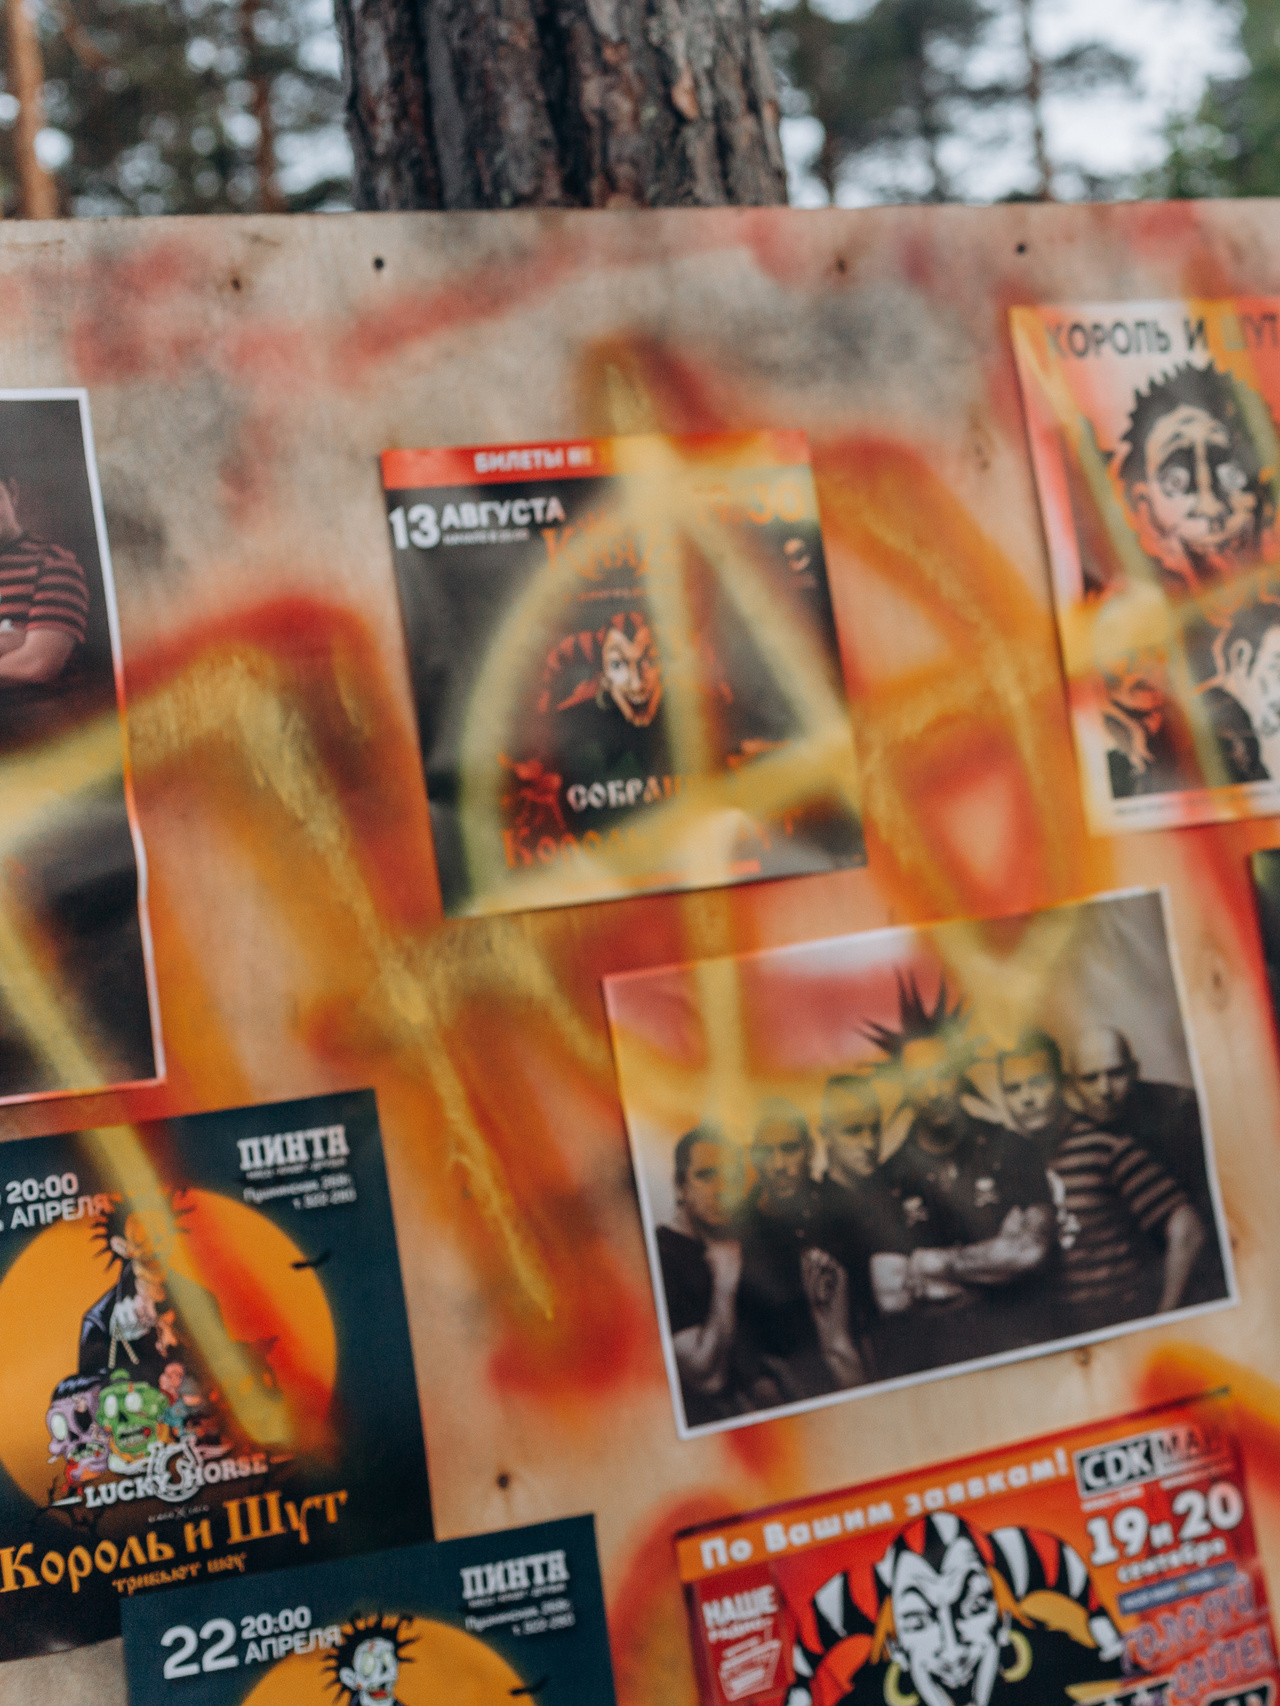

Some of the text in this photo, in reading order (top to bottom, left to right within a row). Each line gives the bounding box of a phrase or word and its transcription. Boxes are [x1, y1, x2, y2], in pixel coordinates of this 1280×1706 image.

[1047, 317, 1172, 359] КОРОЛЬ
[1184, 316, 1208, 351] И
[474, 447, 564, 474] БИЛЕТЫ
[388, 496, 565, 550] 13 АВГУСТА
[237, 1124, 350, 1171] ПИНТА
[5, 1172, 79, 1205] 20:00
[10, 1194, 114, 1230] АПРЕЛЯ
[84, 1452, 269, 1509] LUCKY HORSE
[701, 1535, 754, 1571] По
[764, 1504, 896, 1554] Вашим
[904, 1448, 1071, 1516] заявкам!
[1086, 1505, 1149, 1566] 19
[1172, 1480, 1244, 1542] 20
[0, 1530, 176, 1593] Король
[222, 1489, 349, 1545] Шут
[460, 1549, 571, 1600] ПИНТА
[240, 1604, 313, 1639] 20:00
[702, 1584, 779, 1629] НАШЕ
[160, 1617, 241, 1681] 22
[243, 1624, 344, 1667] АПРЕЛЯ
